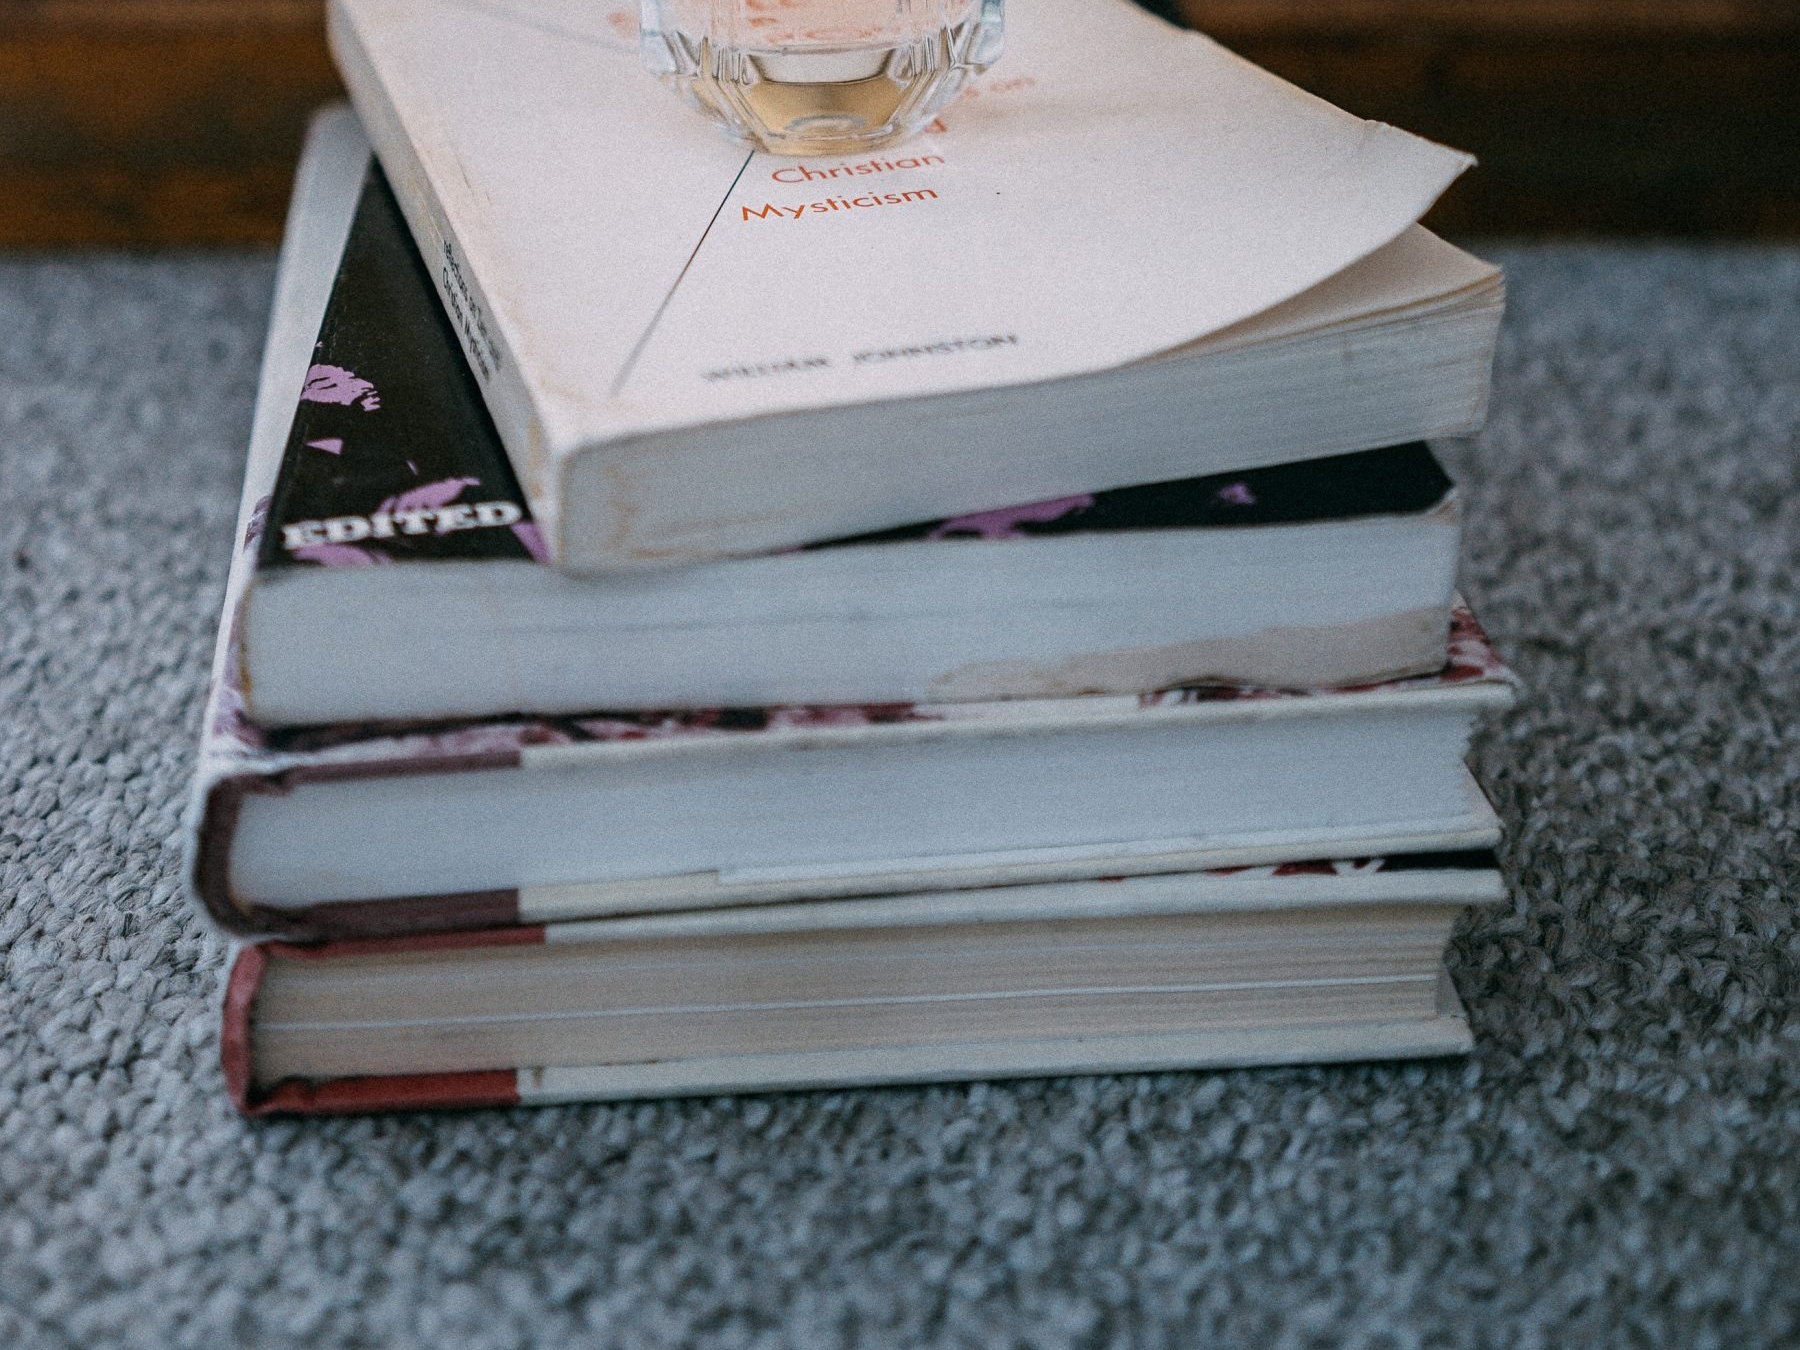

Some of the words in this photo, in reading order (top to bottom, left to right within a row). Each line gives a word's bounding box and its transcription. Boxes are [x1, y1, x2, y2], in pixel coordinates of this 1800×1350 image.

[771, 153, 946, 184] Christian
[741, 186, 939, 221] Mysticism
[281, 500, 522, 550] EDITED
